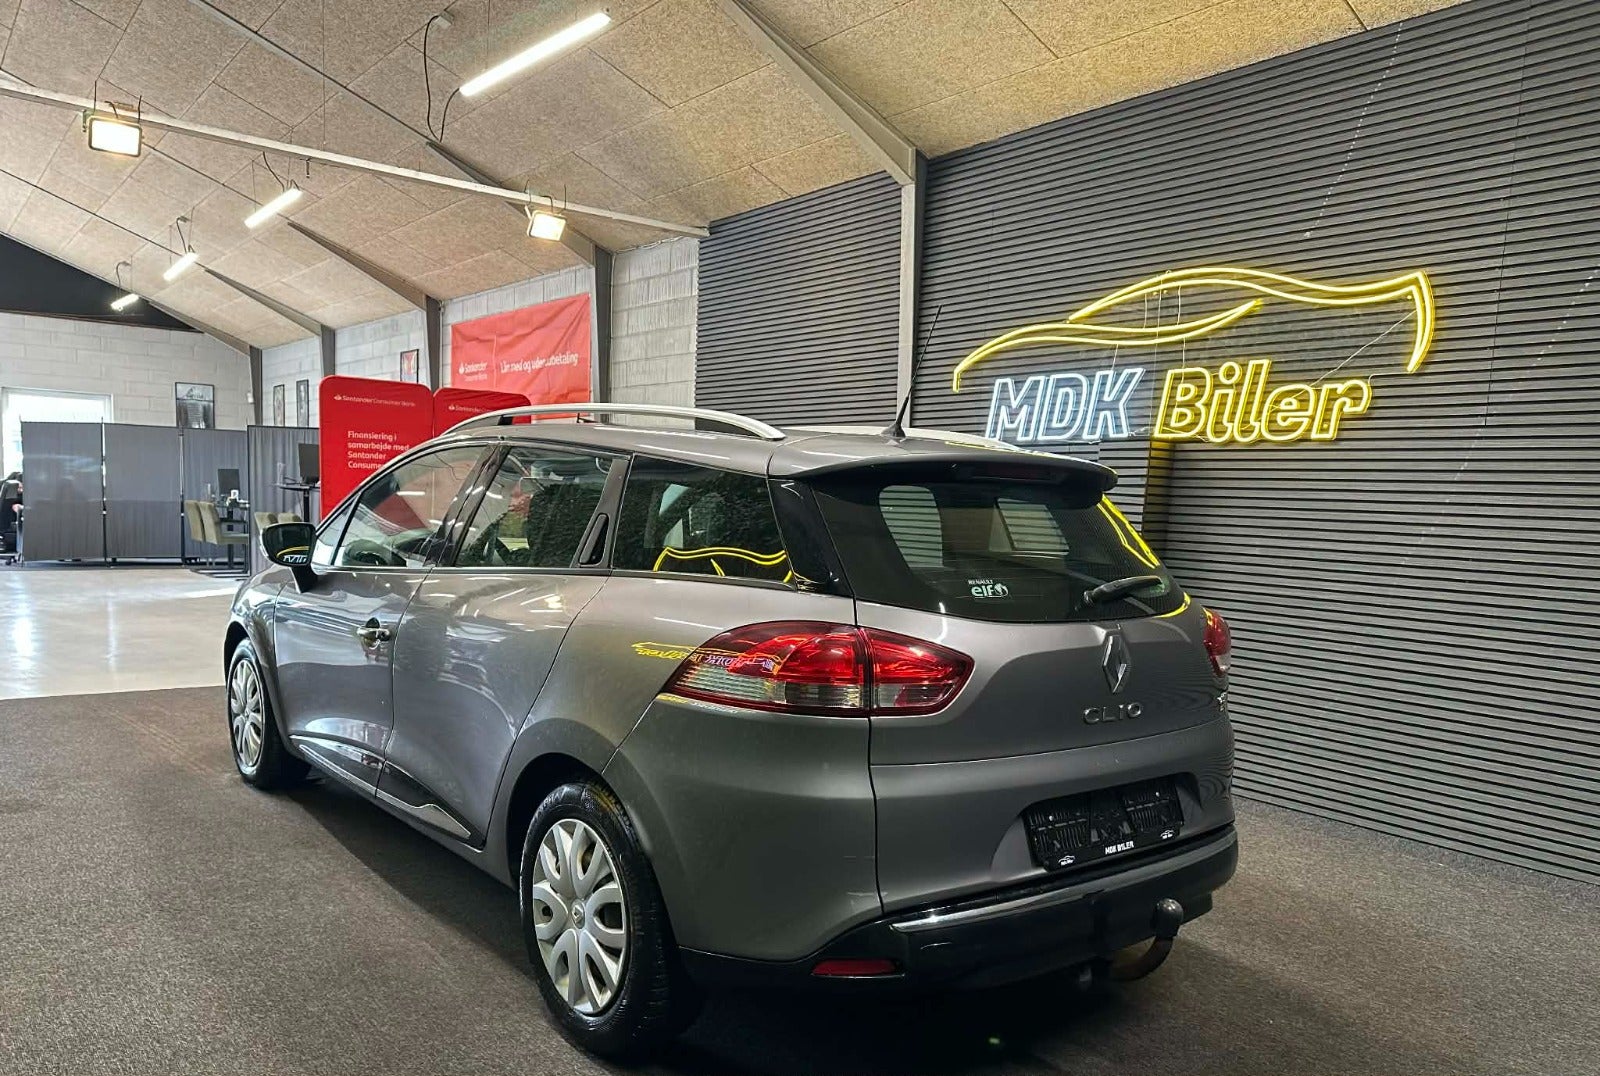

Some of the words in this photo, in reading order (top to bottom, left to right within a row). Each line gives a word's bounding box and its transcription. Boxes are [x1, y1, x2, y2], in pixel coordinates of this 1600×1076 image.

[985, 367, 1146, 441] MDK
[1152, 359, 1371, 444] Biler
[347, 430, 393, 442] Finansiering
[347, 442, 392, 452] samarbejde
[347, 450, 387, 460] Santander
[347, 460, 384, 470] Consume
[971, 585, 995, 597] elf
[1083, 702, 1142, 724] CLIO
